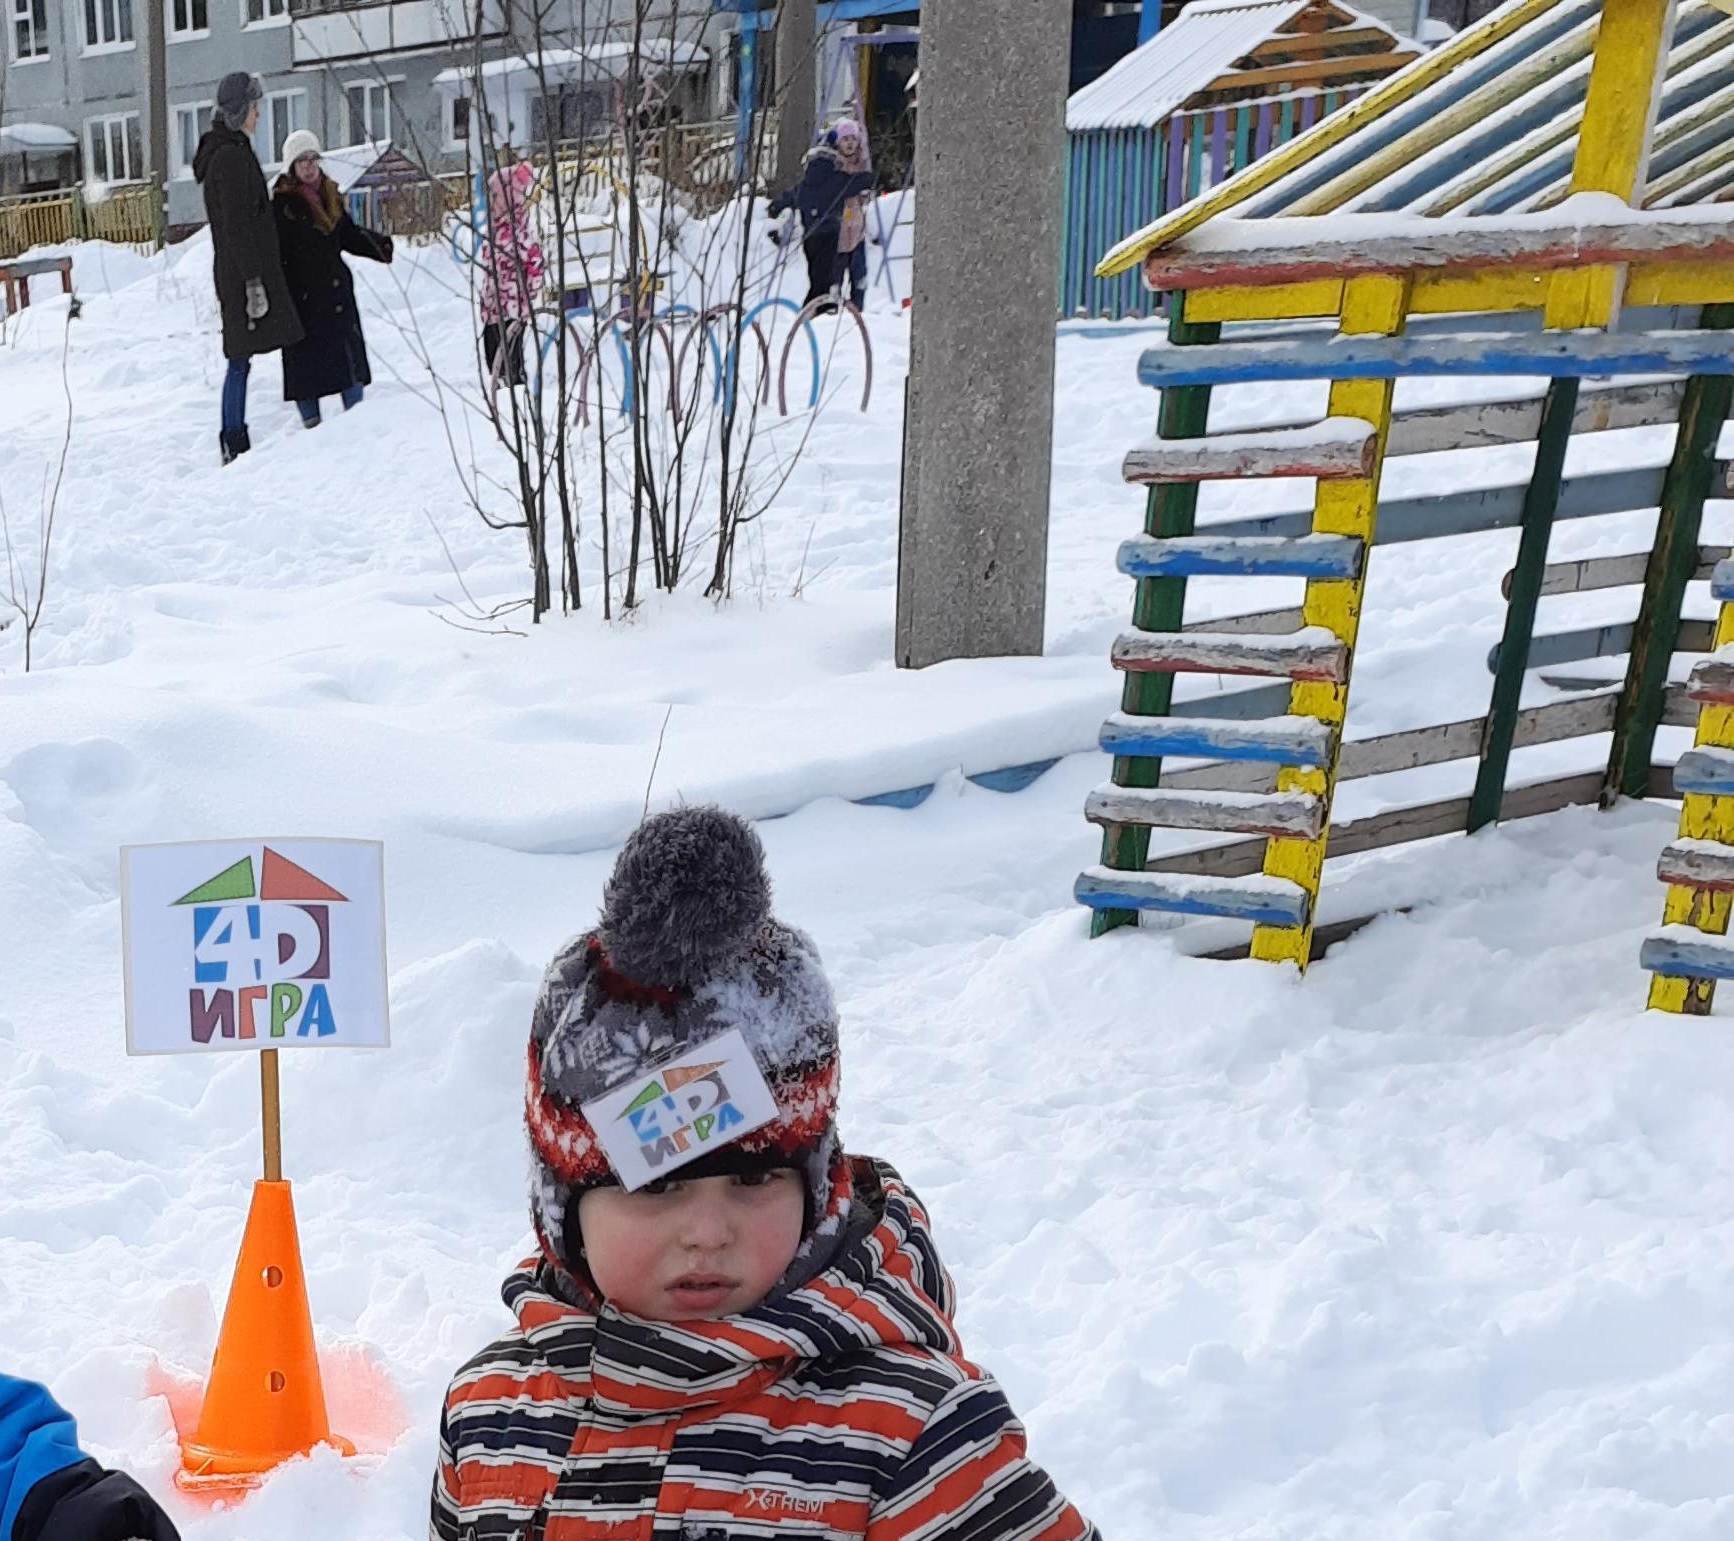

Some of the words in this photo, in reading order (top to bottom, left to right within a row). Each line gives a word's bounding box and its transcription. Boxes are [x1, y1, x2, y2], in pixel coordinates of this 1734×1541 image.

[193, 904, 331, 983] 4D
[189, 982, 337, 1044] ИГРА
[627, 1070, 731, 1143] 4D
[640, 1101, 745, 1169] ИГРА
